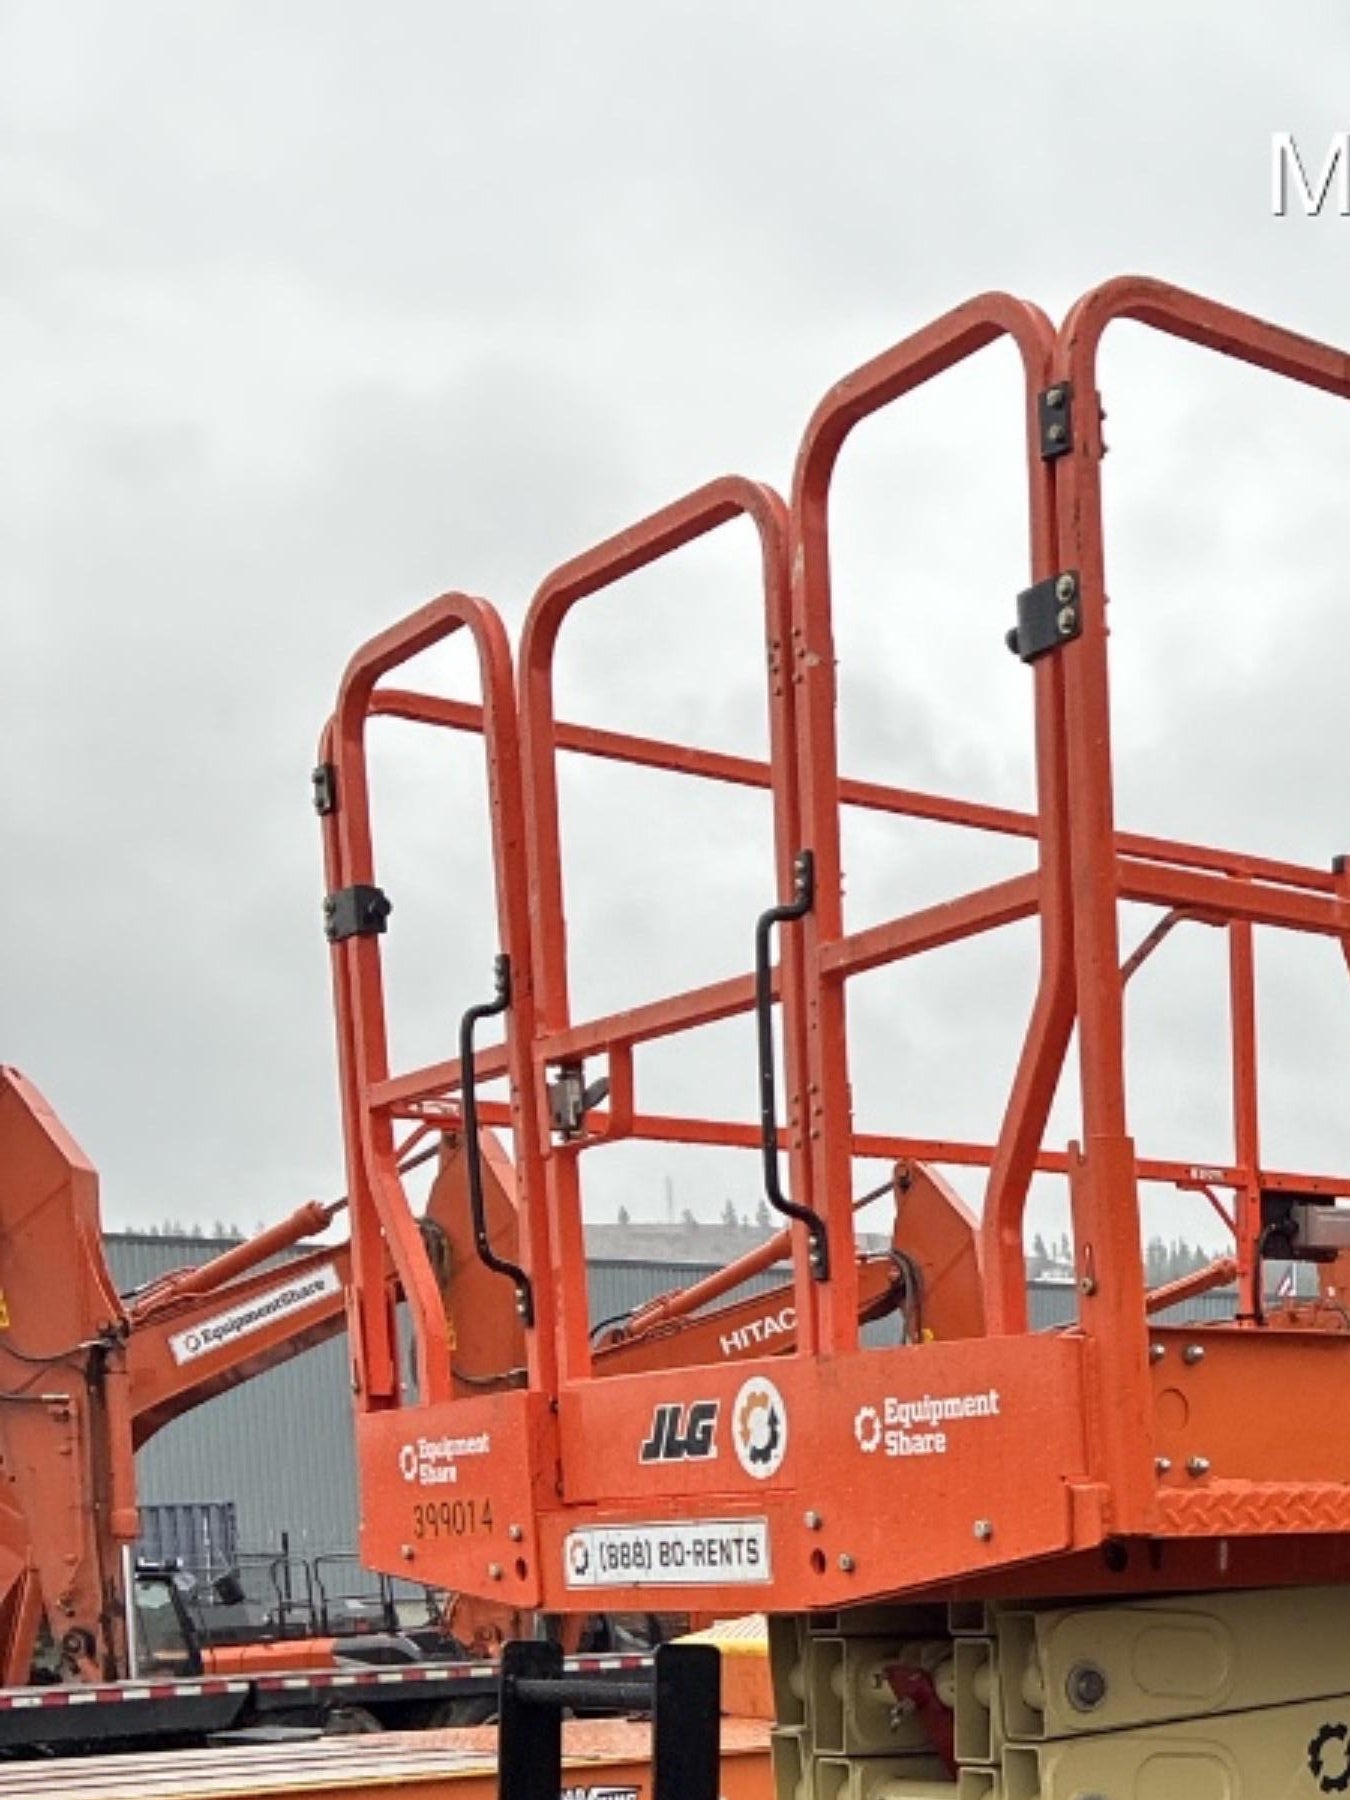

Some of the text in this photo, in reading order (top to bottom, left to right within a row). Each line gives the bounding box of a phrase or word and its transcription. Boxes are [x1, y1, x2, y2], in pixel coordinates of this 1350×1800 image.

[201, 1280, 325, 1342] EquipmentShare
[884, 1389, 1000, 1429] Equipment
[417, 1433, 490, 1463] Equipment
[638, 1399, 720, 1464] JLG
[884, 1430, 946, 1457] Share
[418, 1463, 458, 1485] Share
[413, 1497, 493, 1539] 399014
[599, 1537, 652, 1572] (888)
